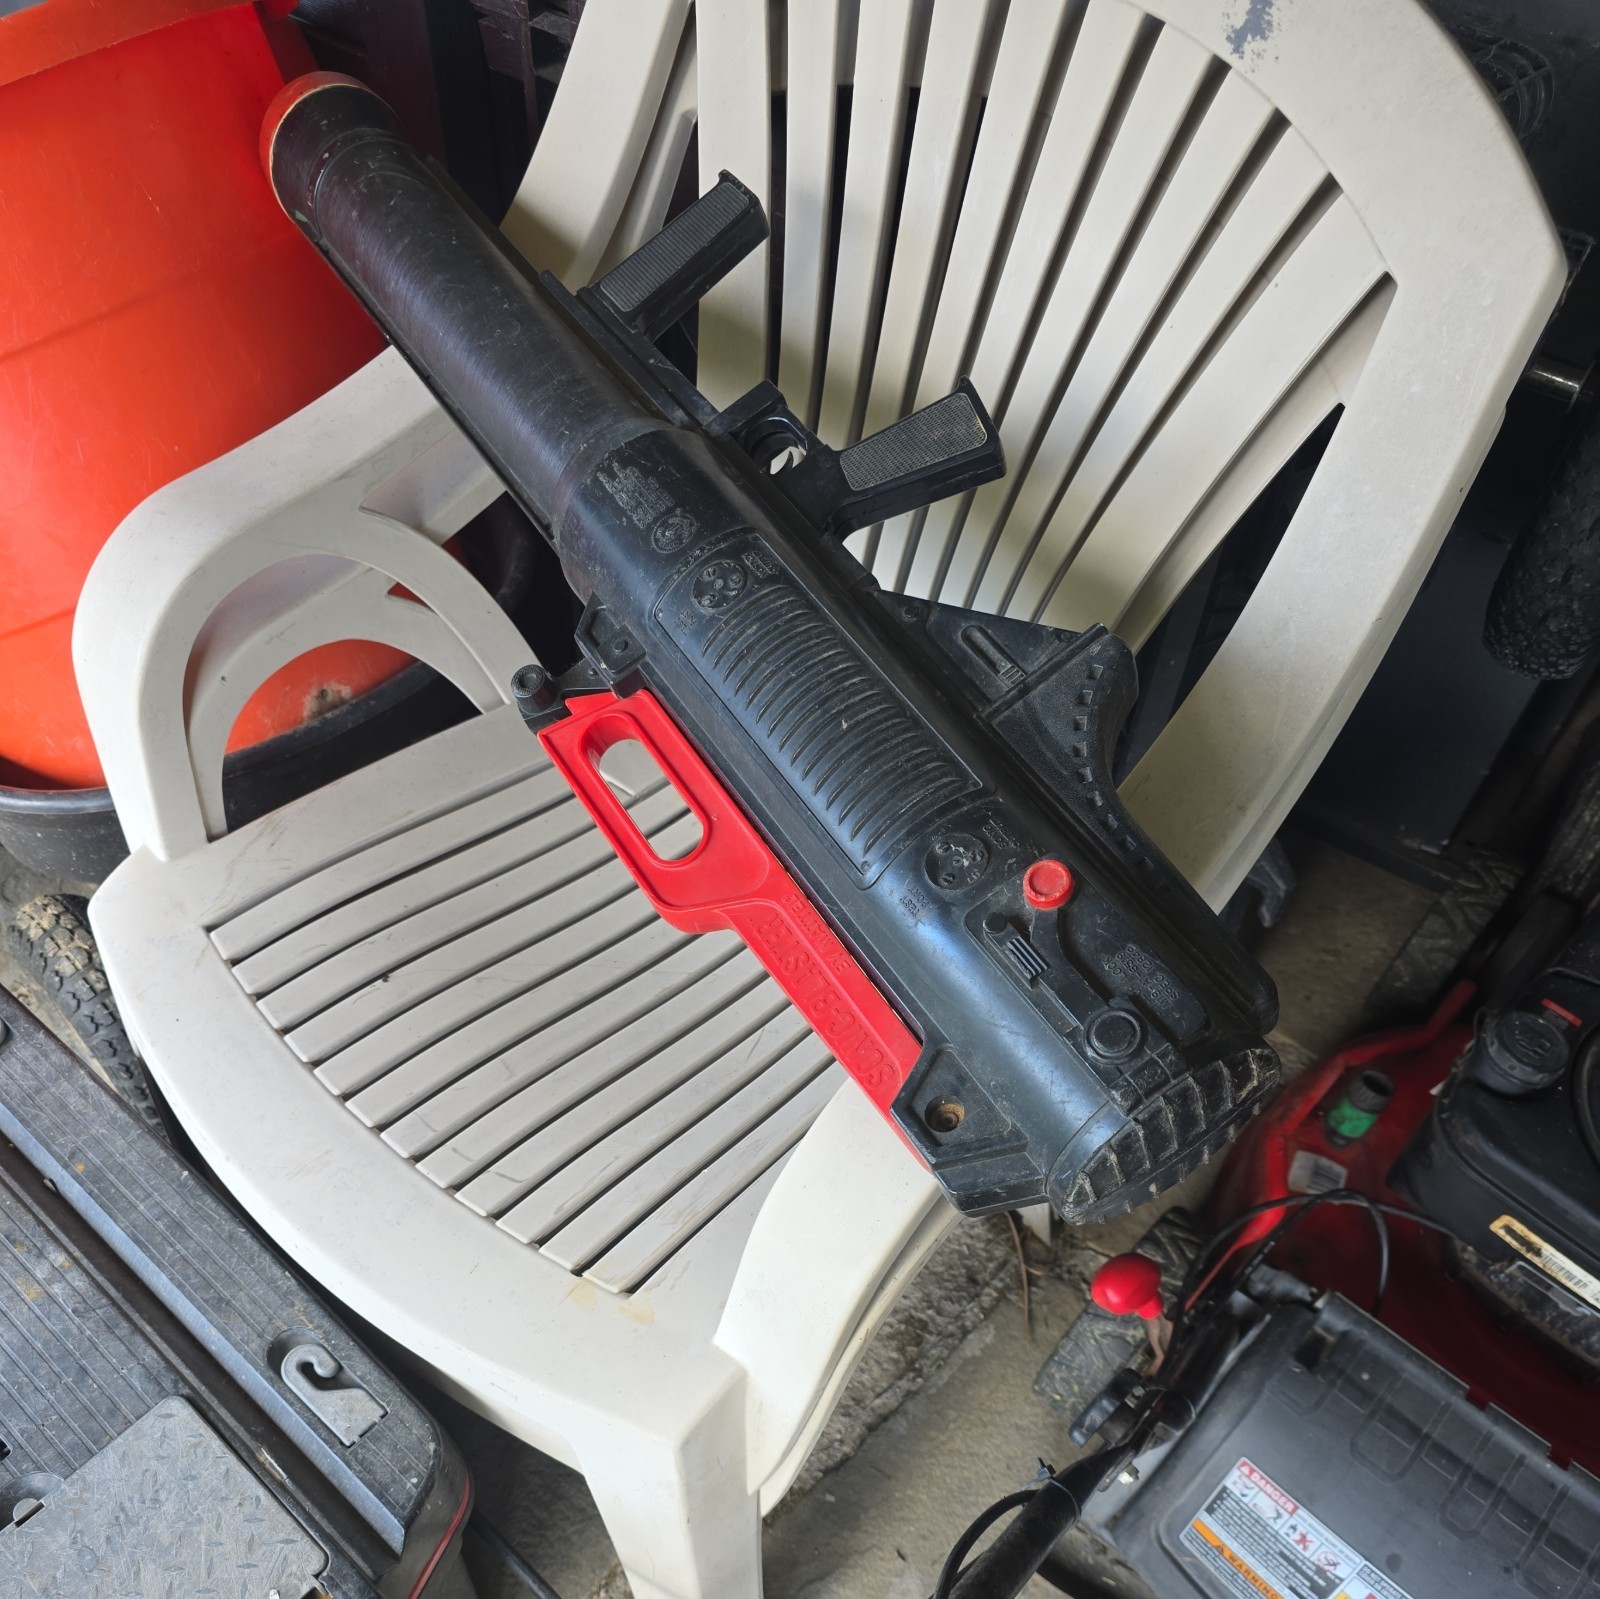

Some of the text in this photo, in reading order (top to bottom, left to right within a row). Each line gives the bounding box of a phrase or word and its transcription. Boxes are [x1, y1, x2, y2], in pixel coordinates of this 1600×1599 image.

[898, 893, 921, 918] TEST
[906, 884, 930, 909] PORT
[827, 949, 852, 975] BY
[1101, 954, 1127, 982] LOCK
[1152, 971, 1181, 1001] SPEC
[1249, 1470, 1295, 1512] DANGER
